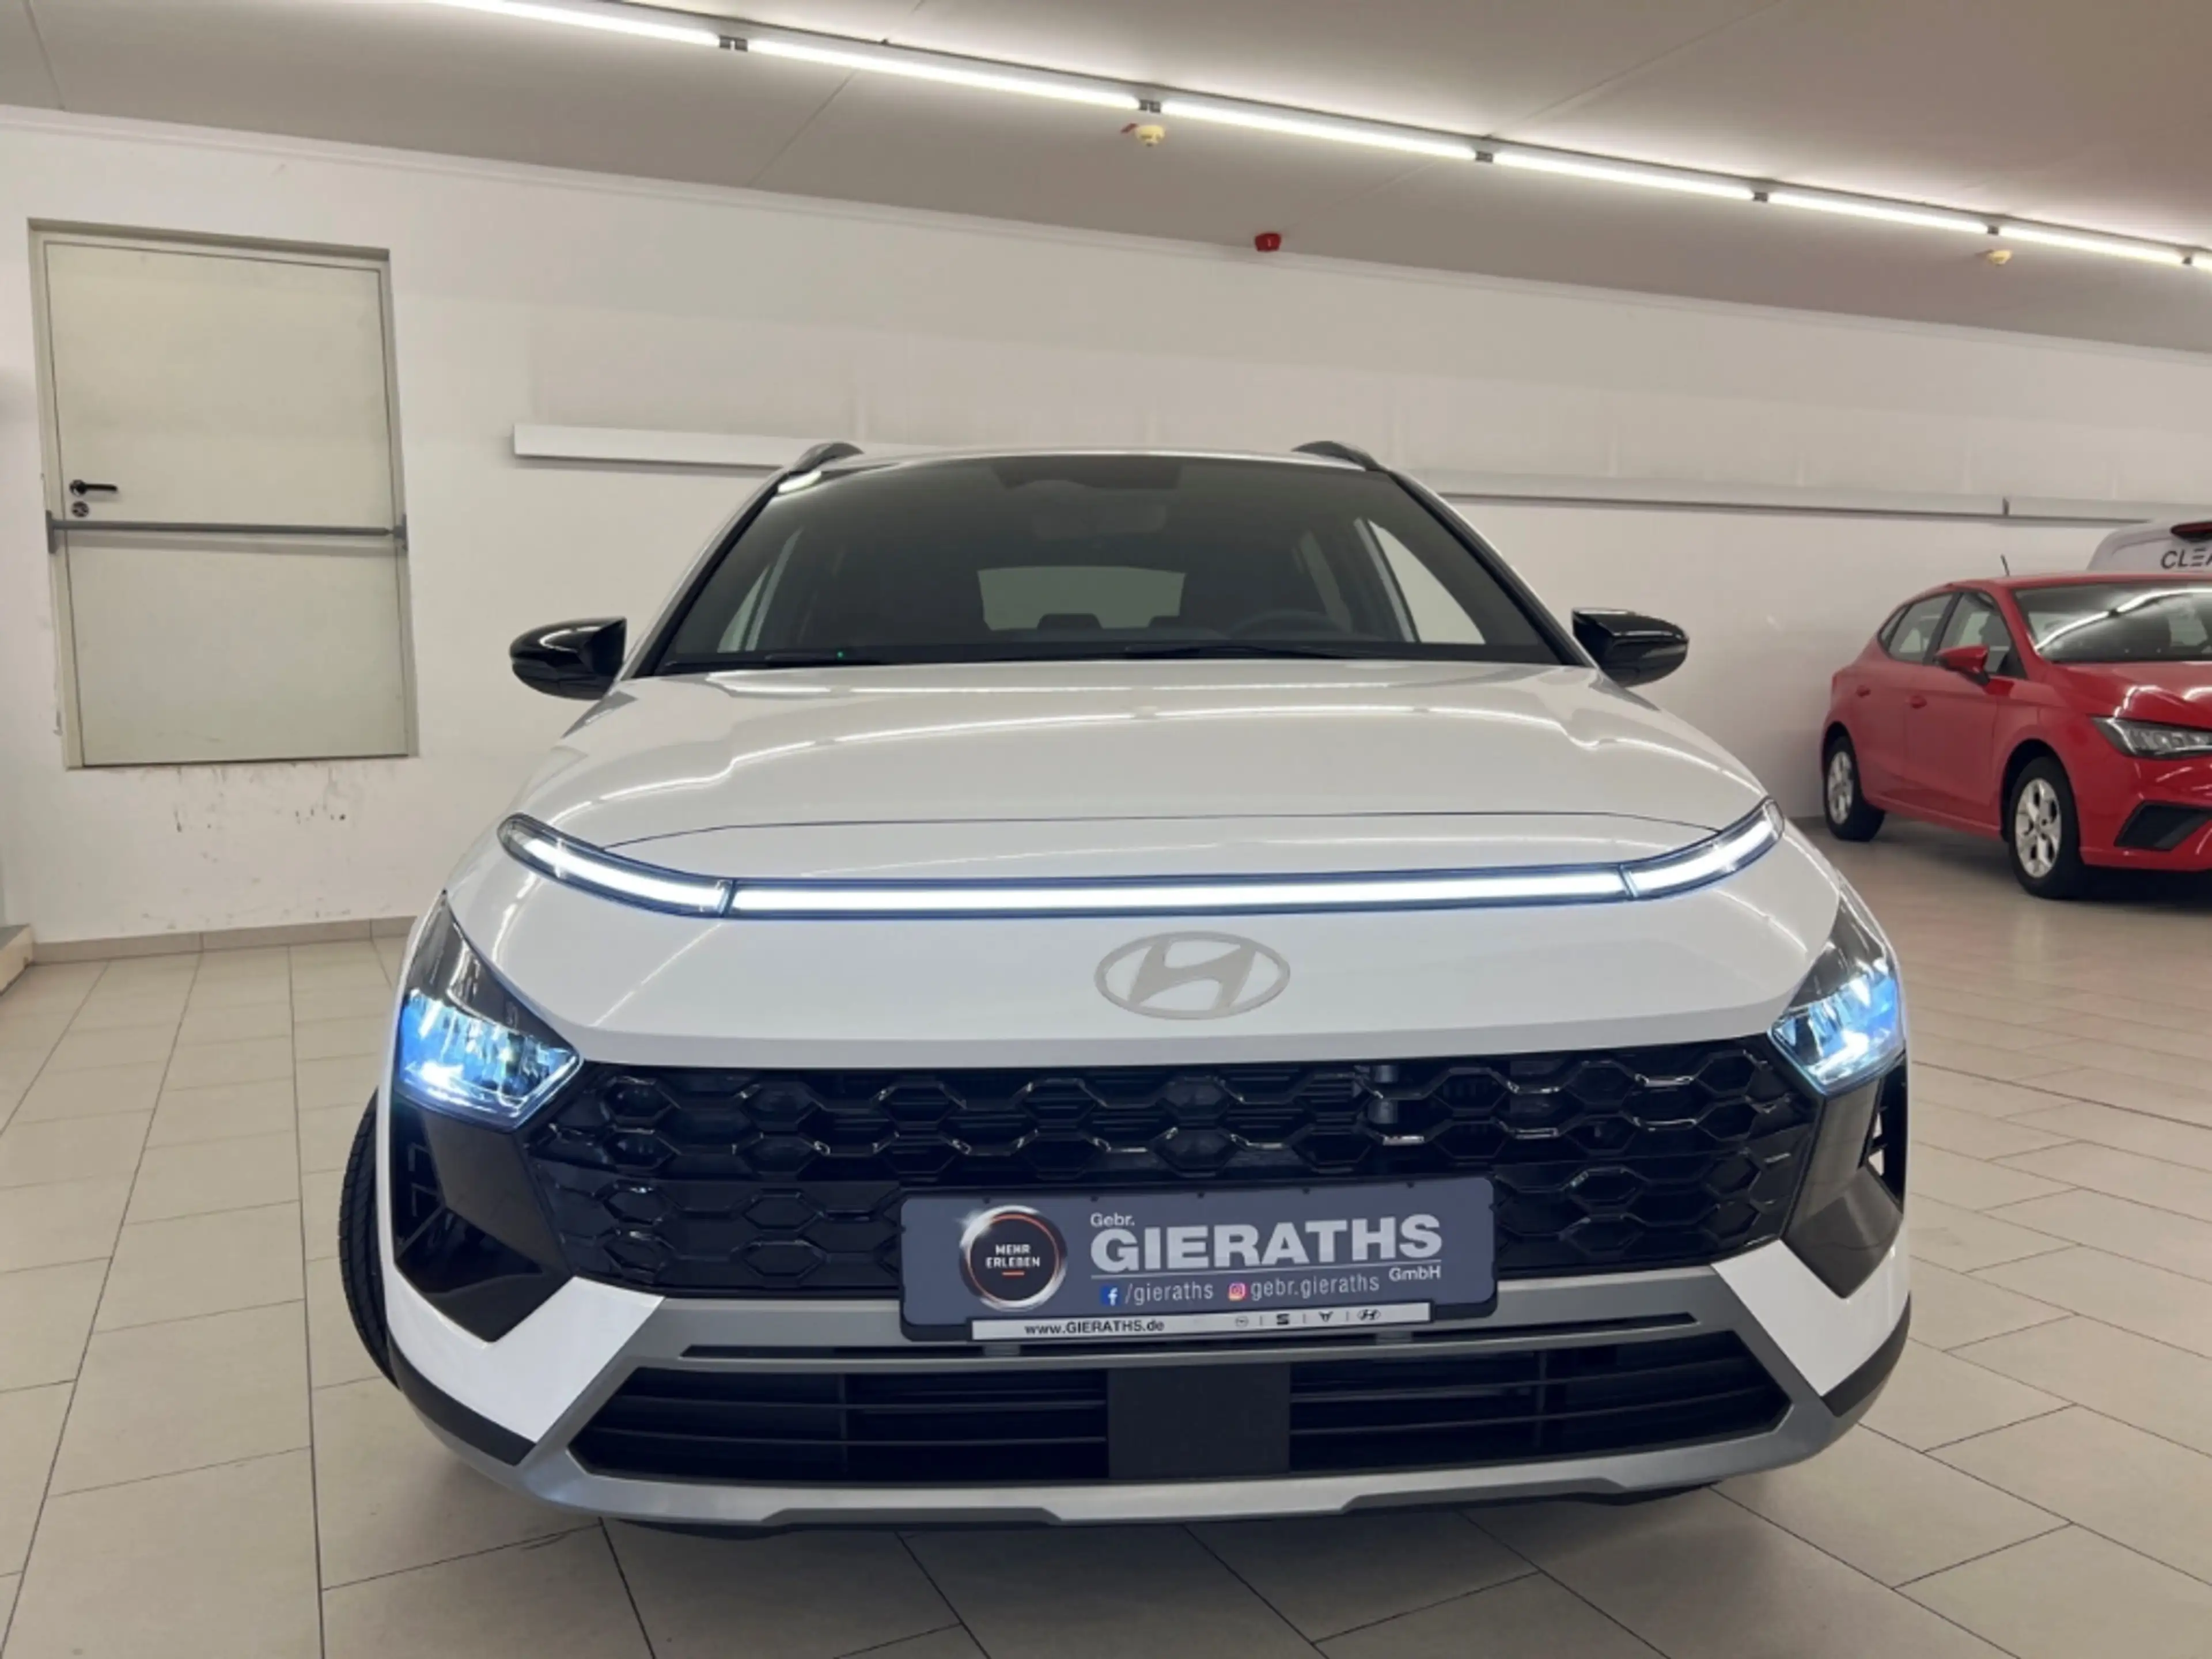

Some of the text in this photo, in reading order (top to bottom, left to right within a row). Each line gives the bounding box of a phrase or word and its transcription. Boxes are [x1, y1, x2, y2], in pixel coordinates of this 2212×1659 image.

[1090, 1212, 1135, 1227] Gebr.
[995, 1244, 1031, 1255] MEHR
[1090, 1214, 1442, 1273] GIERATHS
[986, 1256, 1041, 1268] ERLEBEN
[1388, 1266, 1441, 1282] GmbH
[1251, 1274, 1380, 1301] gebr.gieraths
[1024, 1319, 1165, 1335] www.GIERATHS.de
